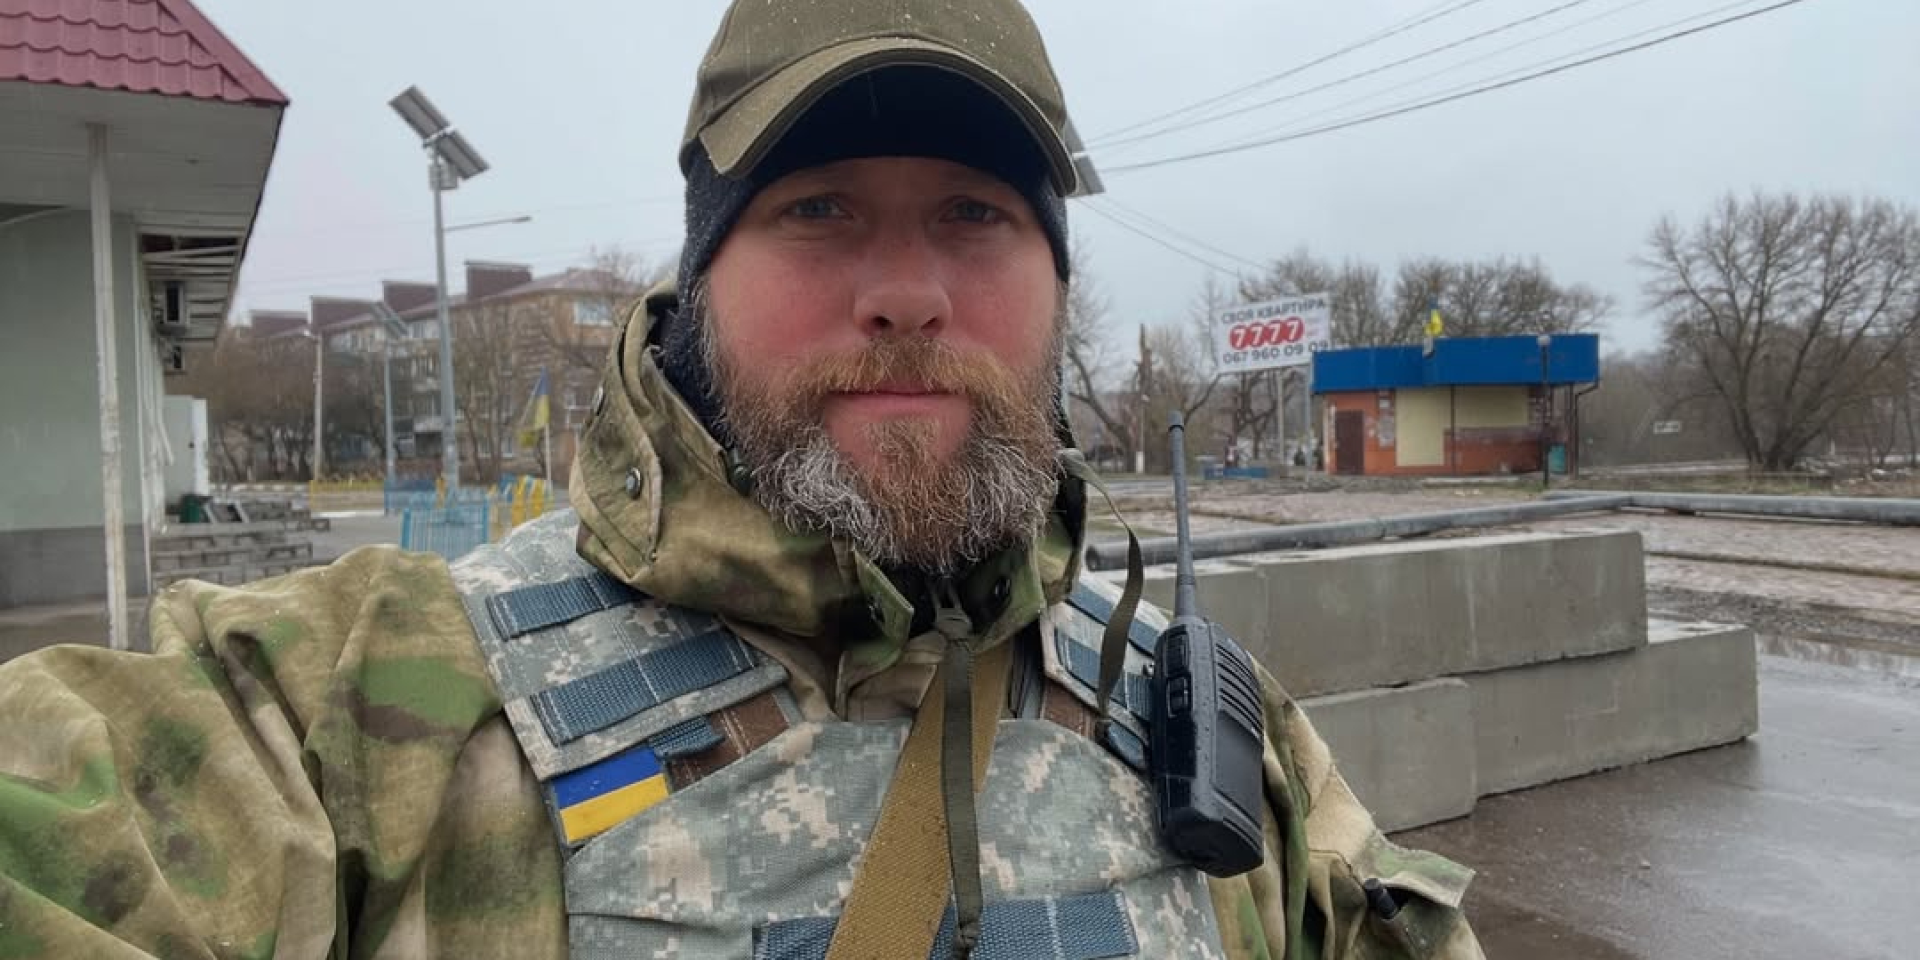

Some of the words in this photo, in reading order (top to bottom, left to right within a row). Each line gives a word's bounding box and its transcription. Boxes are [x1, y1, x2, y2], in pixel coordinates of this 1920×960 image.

[1222, 309, 1253, 324] СВОЯ
[1257, 299, 1325, 318] КВАРТИРА
[1232, 320, 1300, 348] 7777
[1222, 351, 1248, 364] 067
[1252, 347, 1280, 360] 960
[1284, 343, 1304, 356] 09
